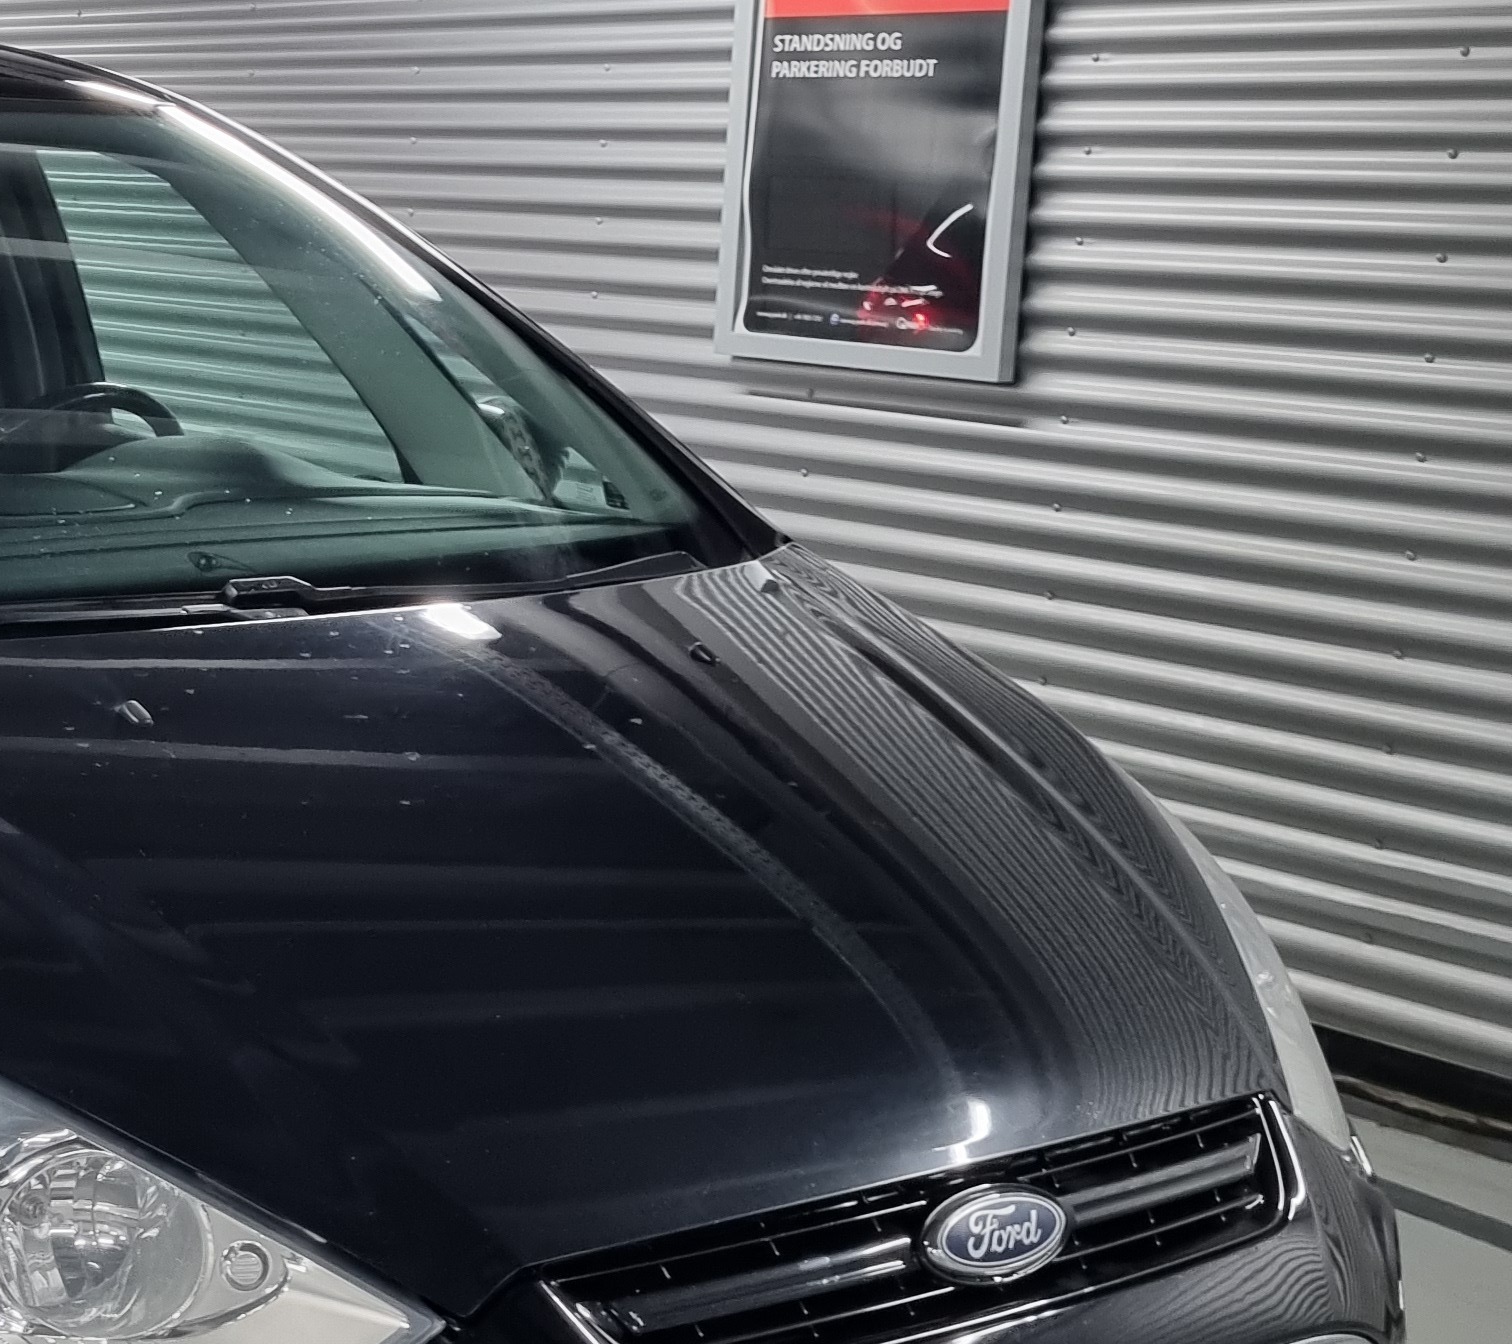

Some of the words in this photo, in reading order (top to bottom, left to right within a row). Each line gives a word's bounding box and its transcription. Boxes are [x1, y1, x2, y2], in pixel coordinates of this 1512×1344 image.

[772, 33, 874, 52] STANDSNING
[876, 31, 903, 51] OG
[770, 59, 858, 78] PARKERING
[859, 58, 938, 78] FORBUDT
[967, 1204, 1042, 1259] Ford
